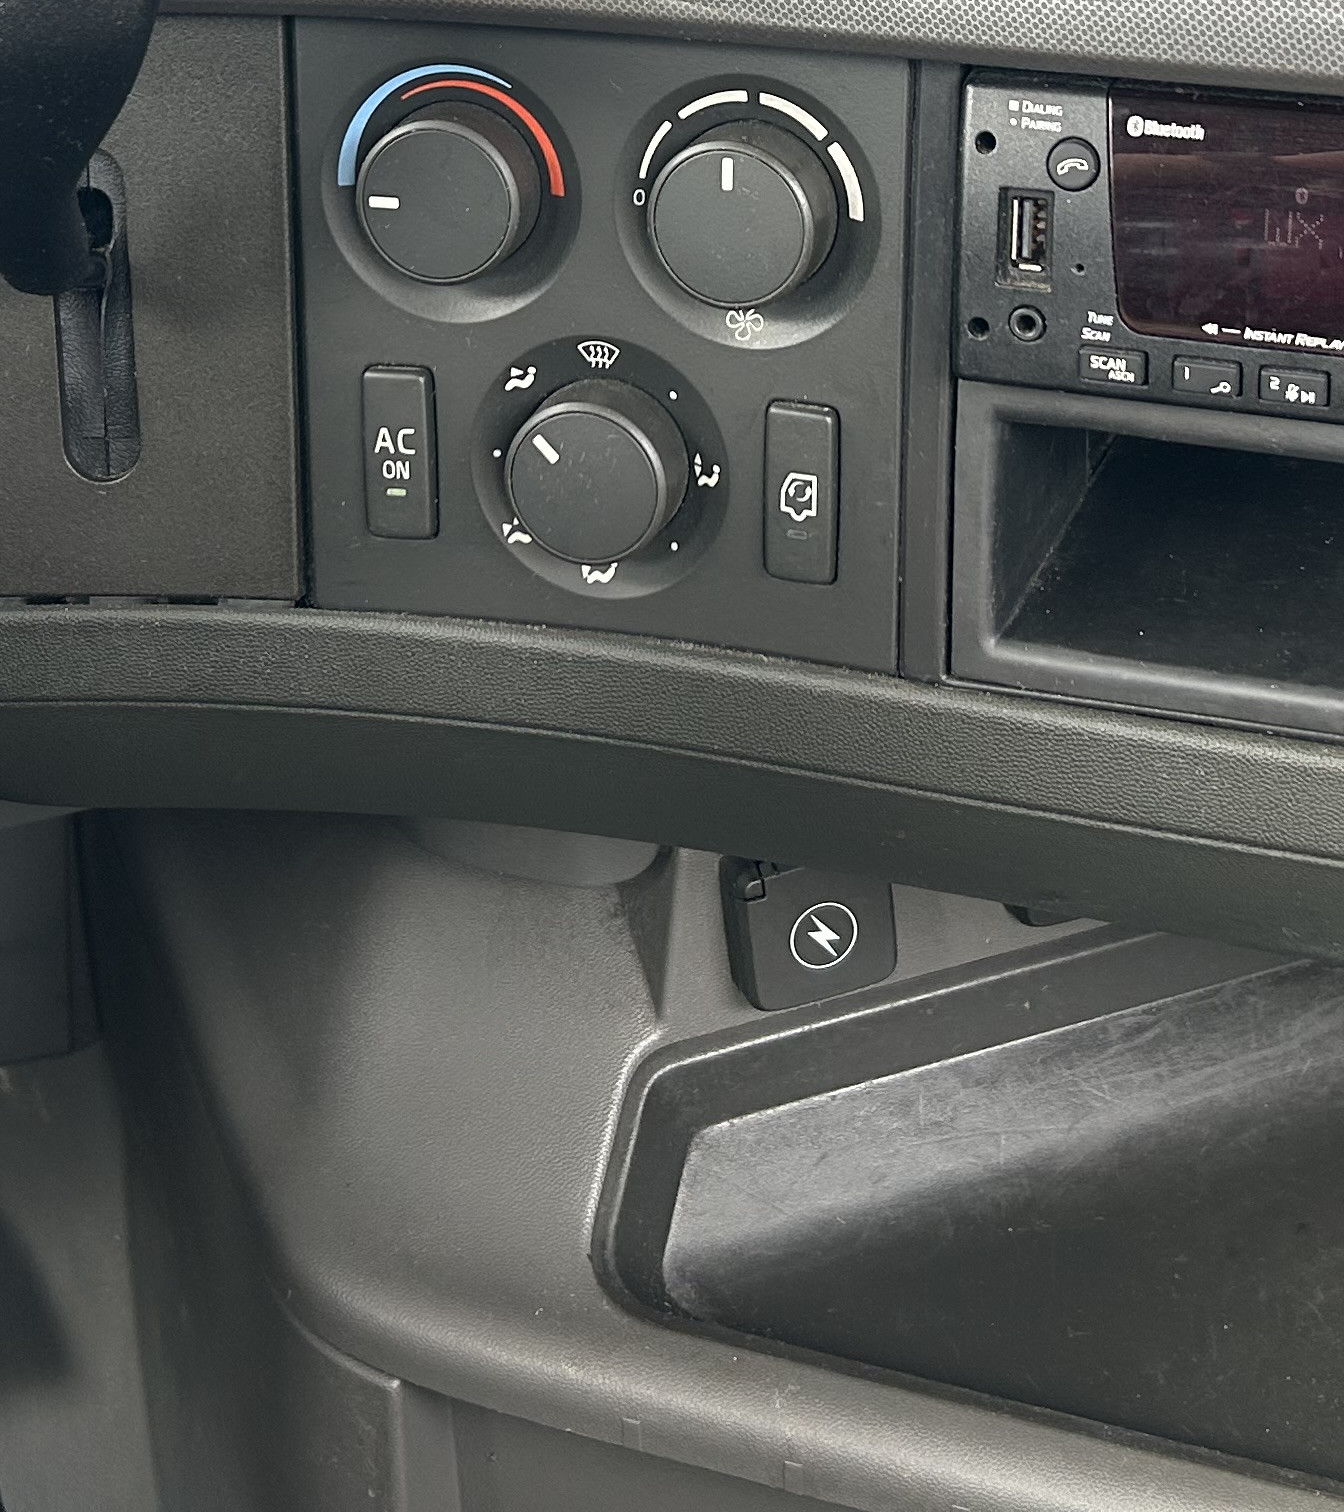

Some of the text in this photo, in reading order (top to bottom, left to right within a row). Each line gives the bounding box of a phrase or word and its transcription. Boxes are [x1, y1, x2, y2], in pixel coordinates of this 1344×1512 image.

[1144, 119, 1206, 140] Bluetooth
[632, 190, 645, 206] 0
[1090, 354, 1127, 373] SCAN
[1184, 366, 1190, 380] 1
[1269, 376, 1280, 390] 2
[374, 427, 416, 455] AC
[382, 460, 410, 480] ON
